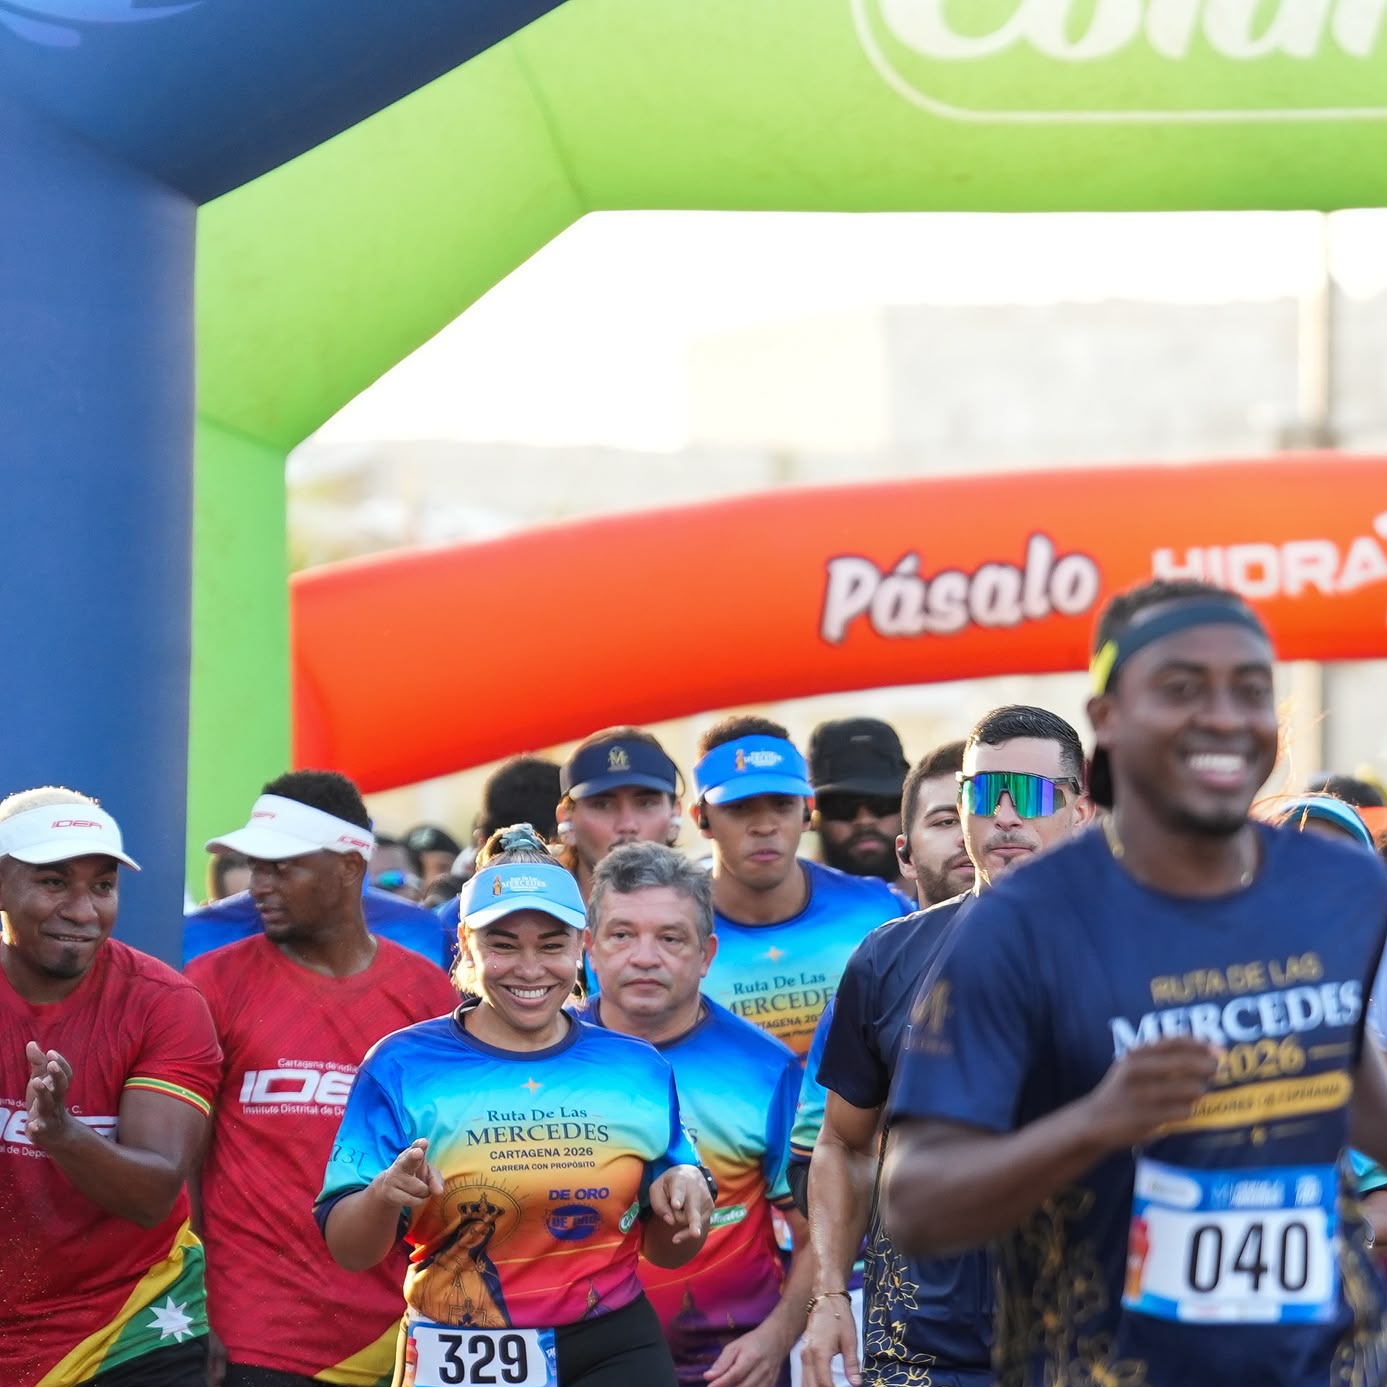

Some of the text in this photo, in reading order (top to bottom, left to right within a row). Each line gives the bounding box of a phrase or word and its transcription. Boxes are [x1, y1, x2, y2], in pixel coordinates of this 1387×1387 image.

[820, 531, 1100, 645] Pásalo
[733, 972, 827, 996] Ruta De Las
[728, 986, 835, 1017] ERCEDE
[1108, 979, 1363, 1060] MERCEDES
[239, 1068, 357, 1105] IDE
[487, 1106, 588, 1122] Ruta De Las
[465, 1121, 610, 1147] MERCEDES
[489, 1147, 594, 1160] CARTAGENA 2026
[490, 1164, 530, 1173] CARRERA
[531, 1162, 549, 1170] CON
[548, 1186, 610, 1201] DE ORO
[1188, 1221, 1309, 1294] 040
[437, 1333, 528, 1385] 329
